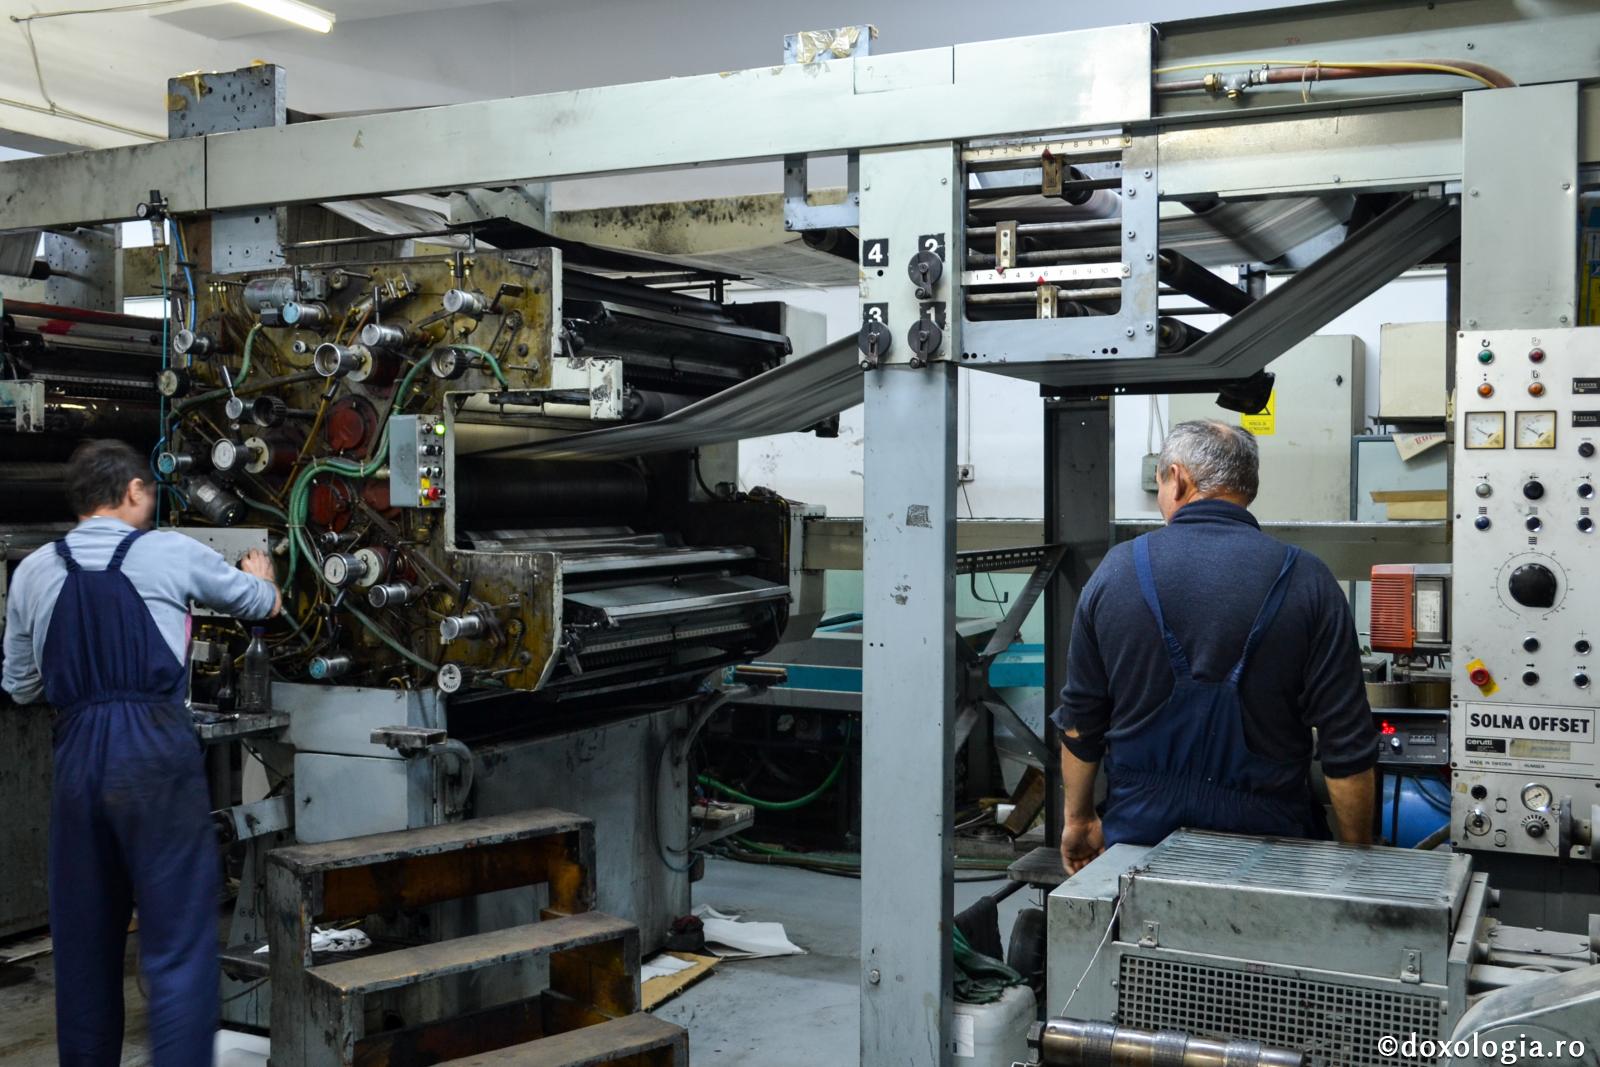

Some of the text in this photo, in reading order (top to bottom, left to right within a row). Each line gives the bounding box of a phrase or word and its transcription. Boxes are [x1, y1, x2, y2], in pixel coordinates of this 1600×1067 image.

[1102, 137, 1110, 145] 10
[924, 238, 938, 252] 2
[868, 243, 883, 263] 4
[1101, 267, 1109, 275] 10
[869, 306, 883, 322] 3
[926, 306, 936, 321] 1
[1470, 713, 1590, 733] SOLNA OFFSET
